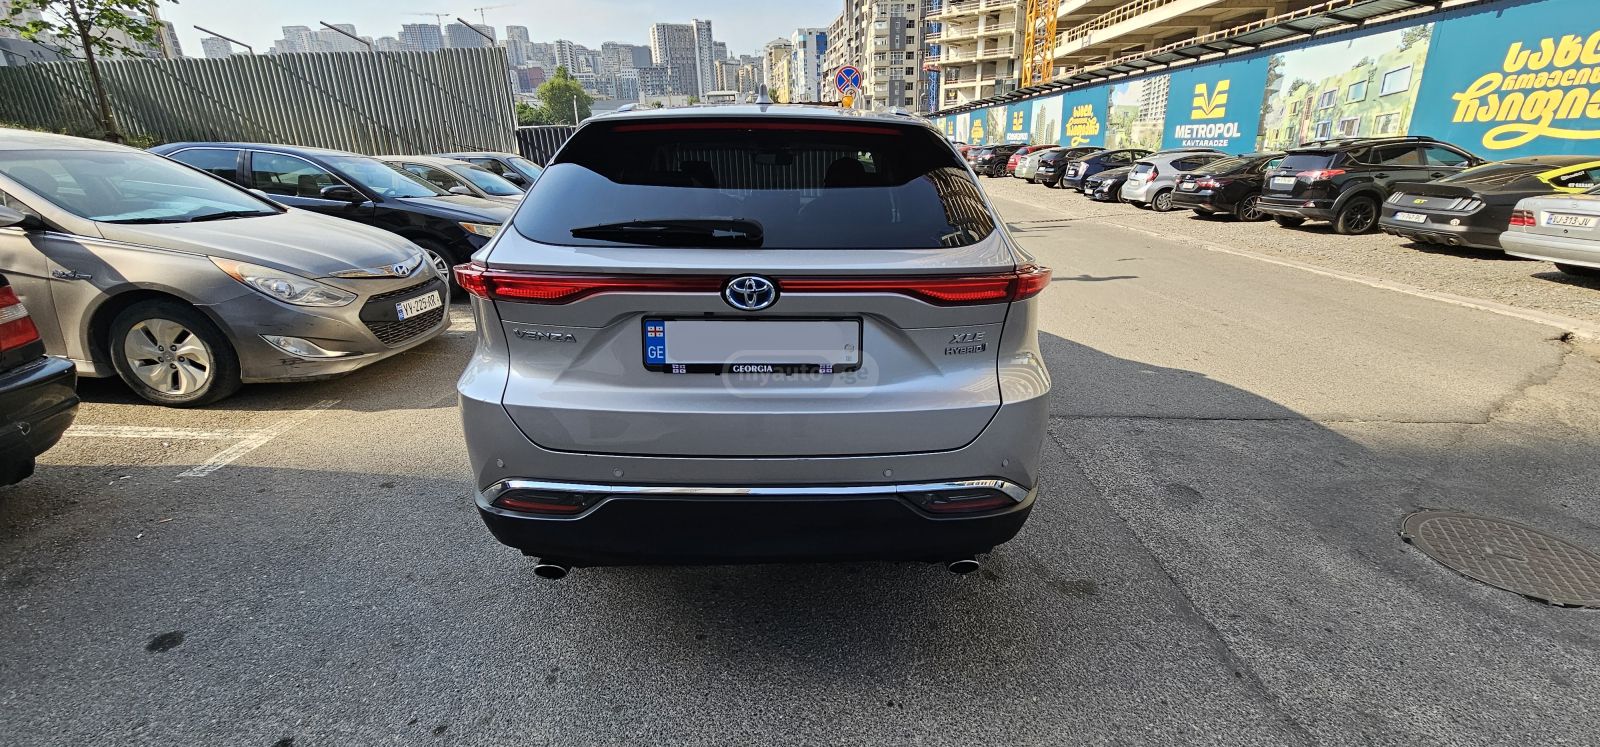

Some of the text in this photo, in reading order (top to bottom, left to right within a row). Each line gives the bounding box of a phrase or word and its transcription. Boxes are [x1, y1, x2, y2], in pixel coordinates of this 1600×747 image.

[1175, 122, 1241, 139] METROPOL
[1182, 139, 1229, 147] KAVTARADZE
[513, 328, 577, 343] VENZA
[949, 332, 986, 344] XLE
[648, 346, 664, 359] GE
[945, 343, 985, 355] HYBRID
[732, 365, 773, 373] GEORGIA
